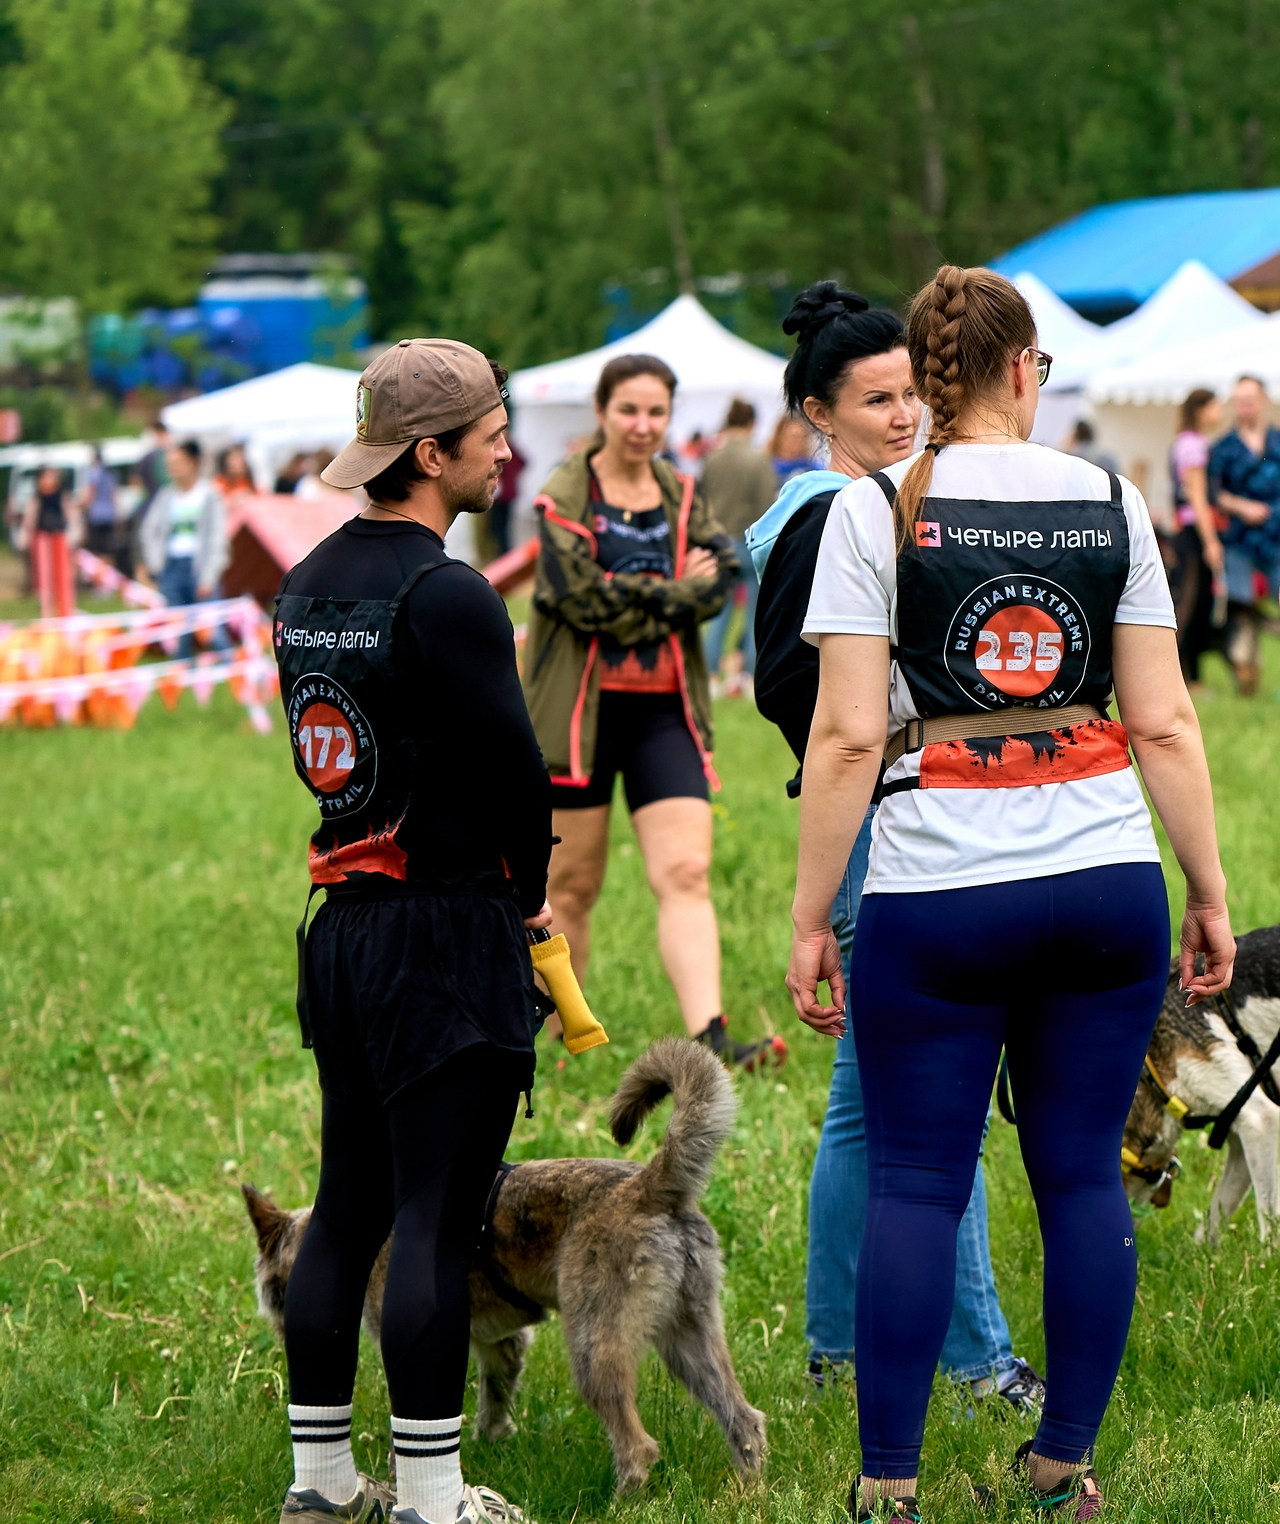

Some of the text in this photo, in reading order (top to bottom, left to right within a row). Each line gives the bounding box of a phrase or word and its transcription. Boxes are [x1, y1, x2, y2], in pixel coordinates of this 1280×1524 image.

[947, 526, 1112, 549] четыре лапы
[283, 628, 380, 649] четыре лапы
[955, 584, 1083, 652] RUSSIAN EXTREME
[975, 630, 1062, 672] 235
[319, 683, 370, 748] EXTREME
[298, 725, 356, 769] 172
[326, 784, 364, 811] TRAIL
